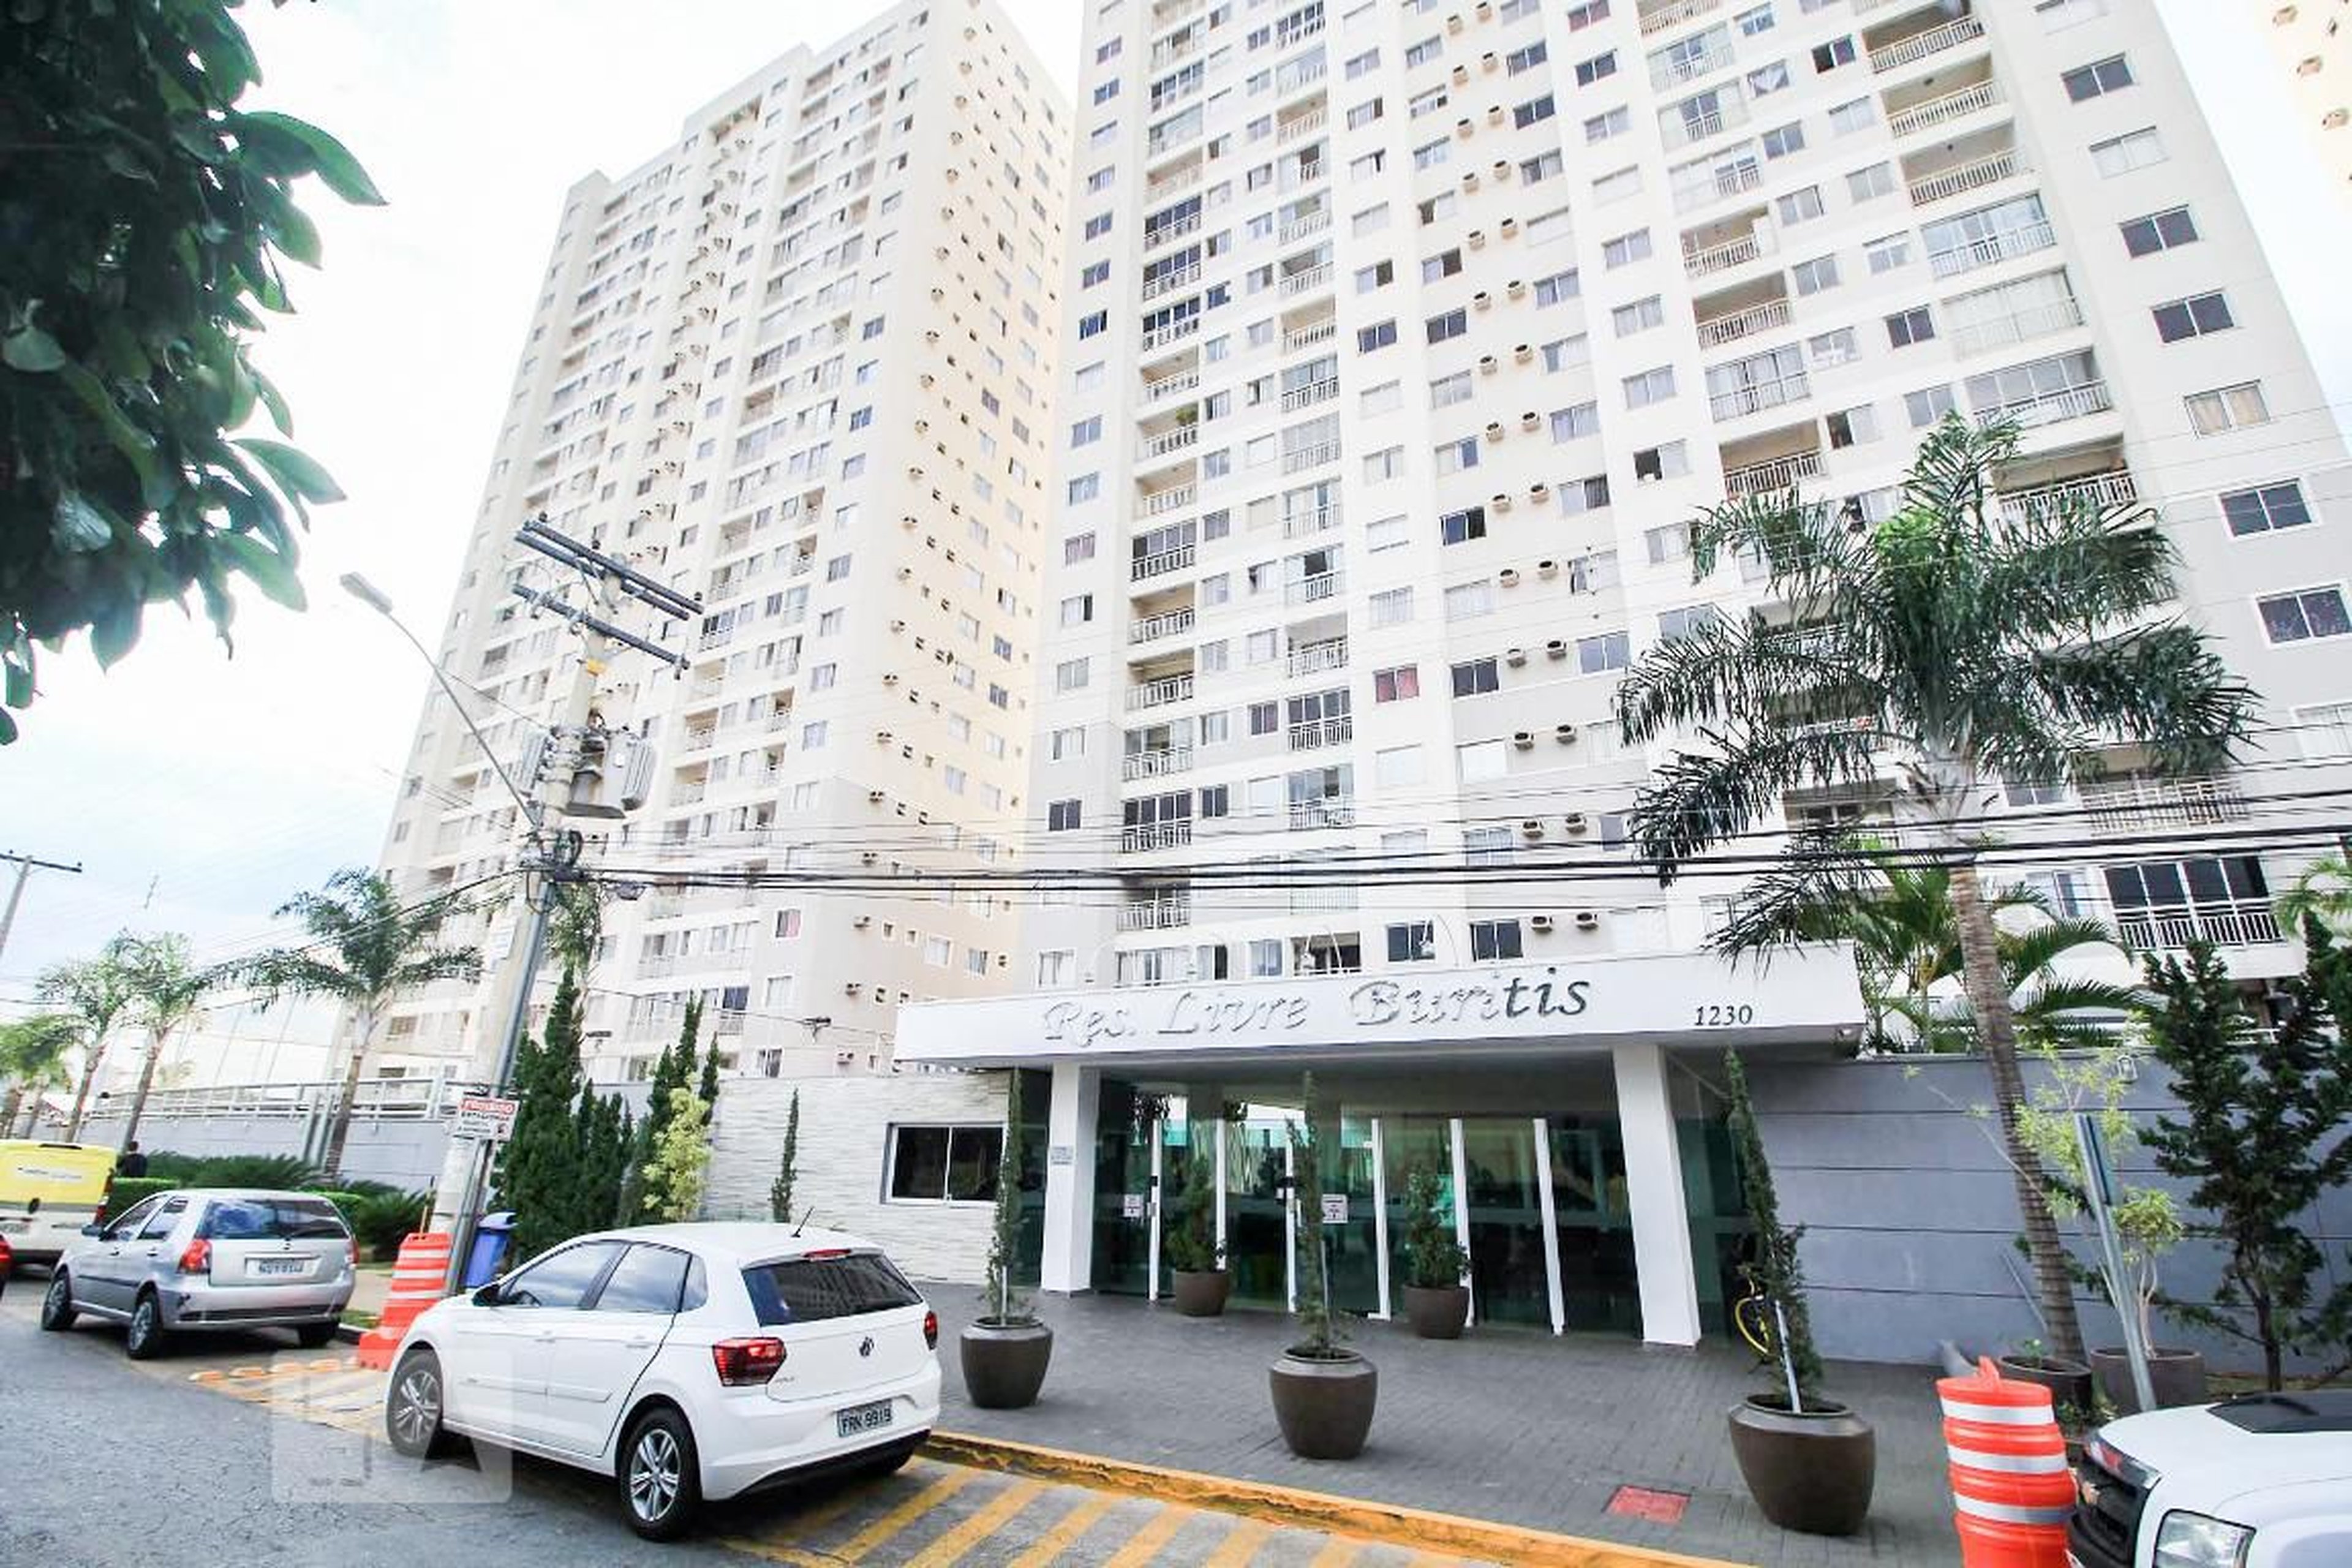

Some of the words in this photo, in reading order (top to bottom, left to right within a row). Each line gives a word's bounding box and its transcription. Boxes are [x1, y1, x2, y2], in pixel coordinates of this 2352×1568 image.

[1158, 992, 1308, 1034] Livre
[1349, 967, 1590, 1025] Buritis
[1695, 1005, 1753, 1026] 1230
